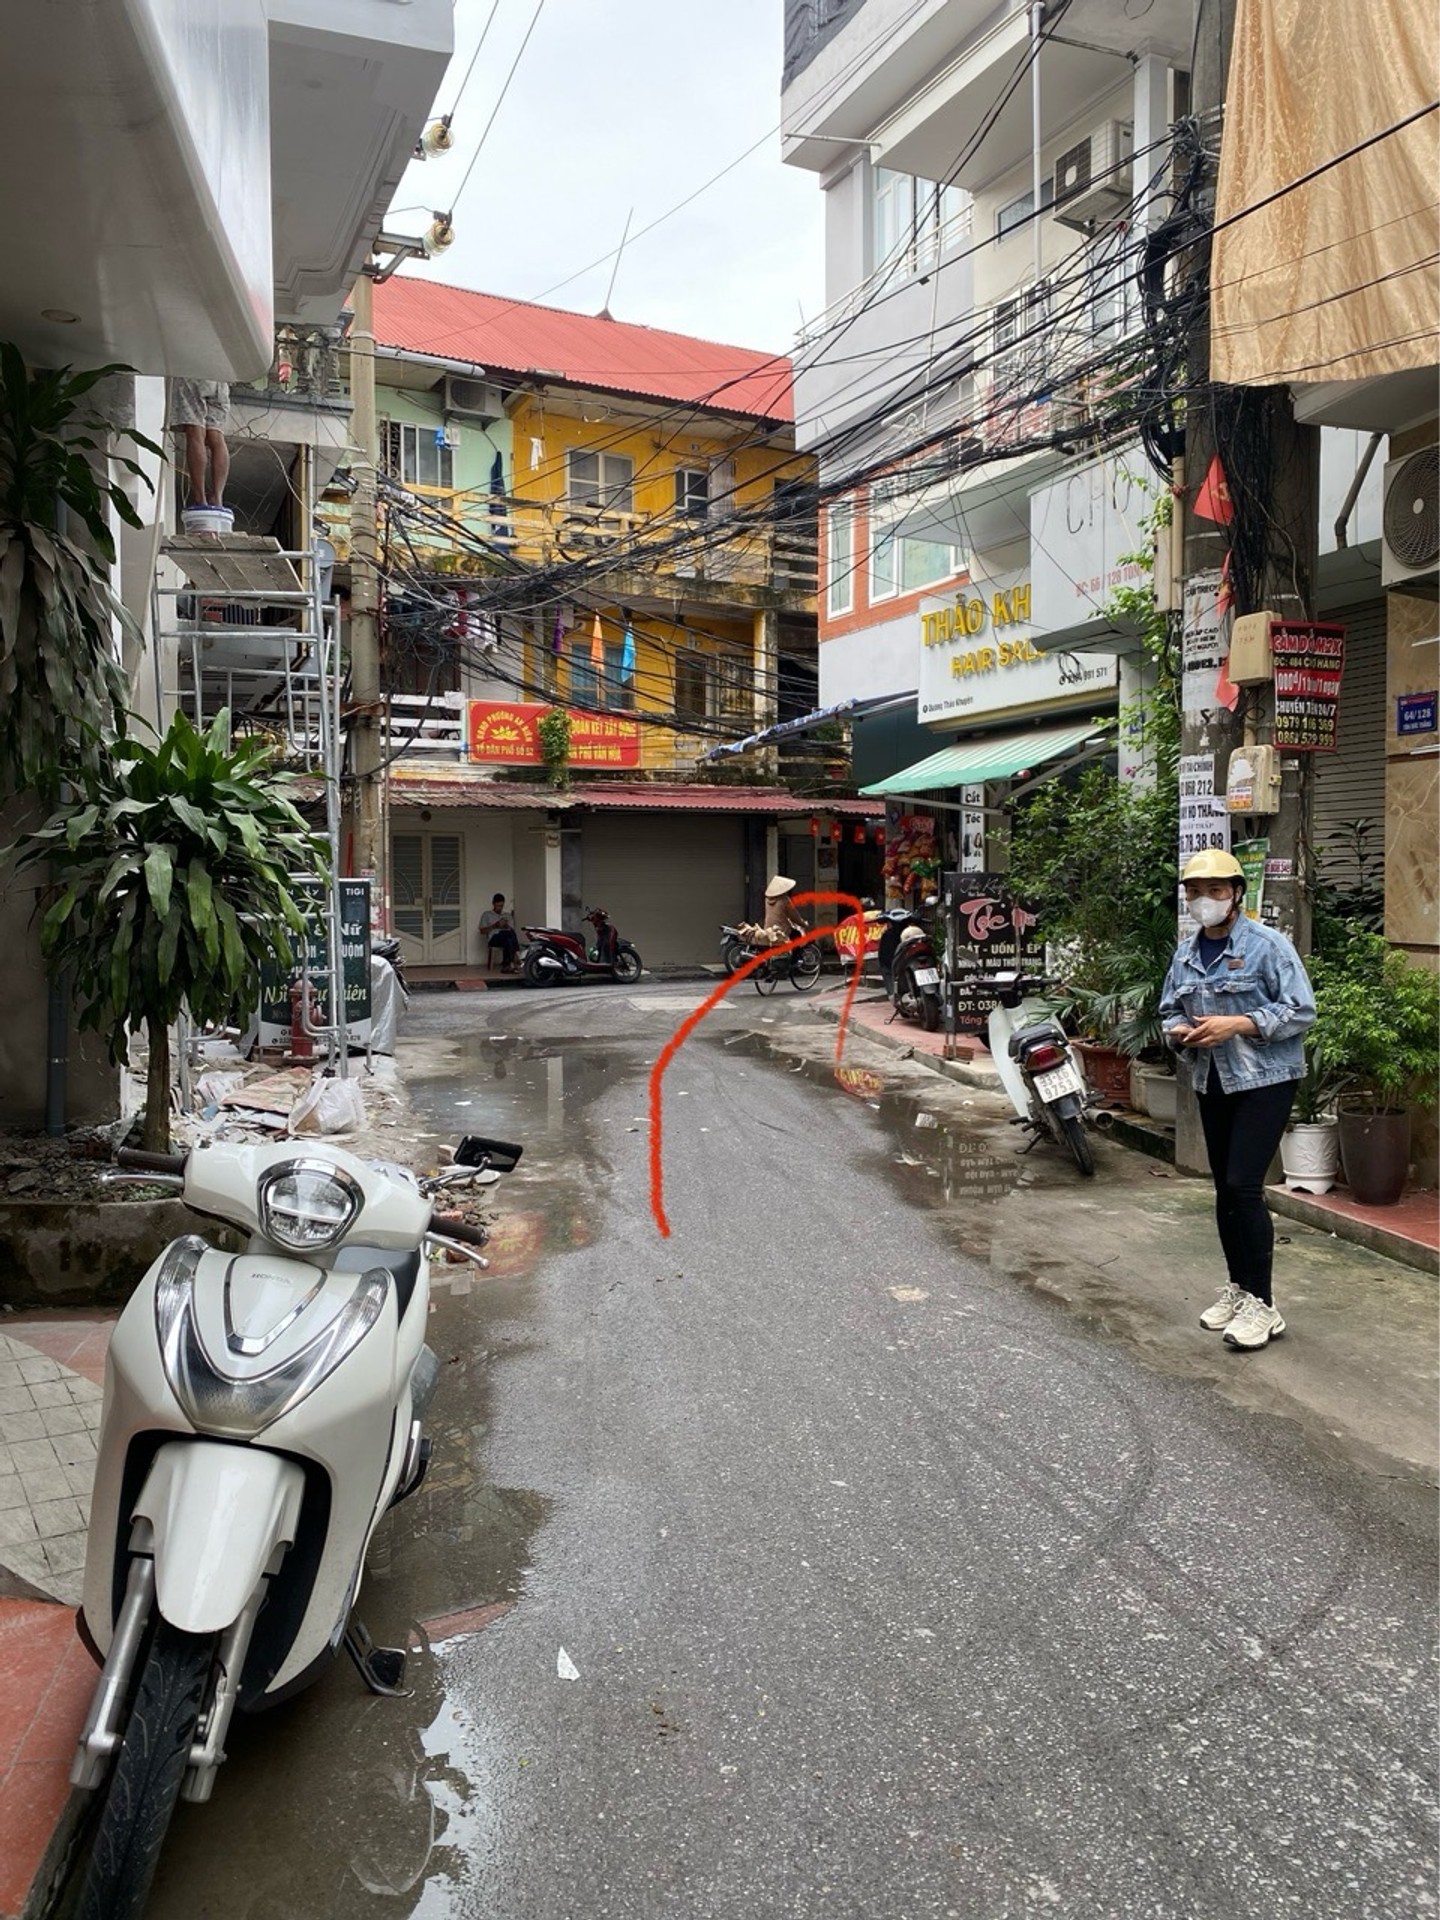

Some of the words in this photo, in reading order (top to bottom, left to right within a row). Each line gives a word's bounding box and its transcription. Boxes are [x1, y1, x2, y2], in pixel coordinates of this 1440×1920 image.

[921, 592, 986, 647] THẢO
[951, 648, 998, 677] HAIR
[1197, 779, 1213, 796] 212
[345, 887, 366, 896] TIGI
[958, 1000, 975, 1012] ĐT:
[250, 1272, 292, 1286] HONDA
